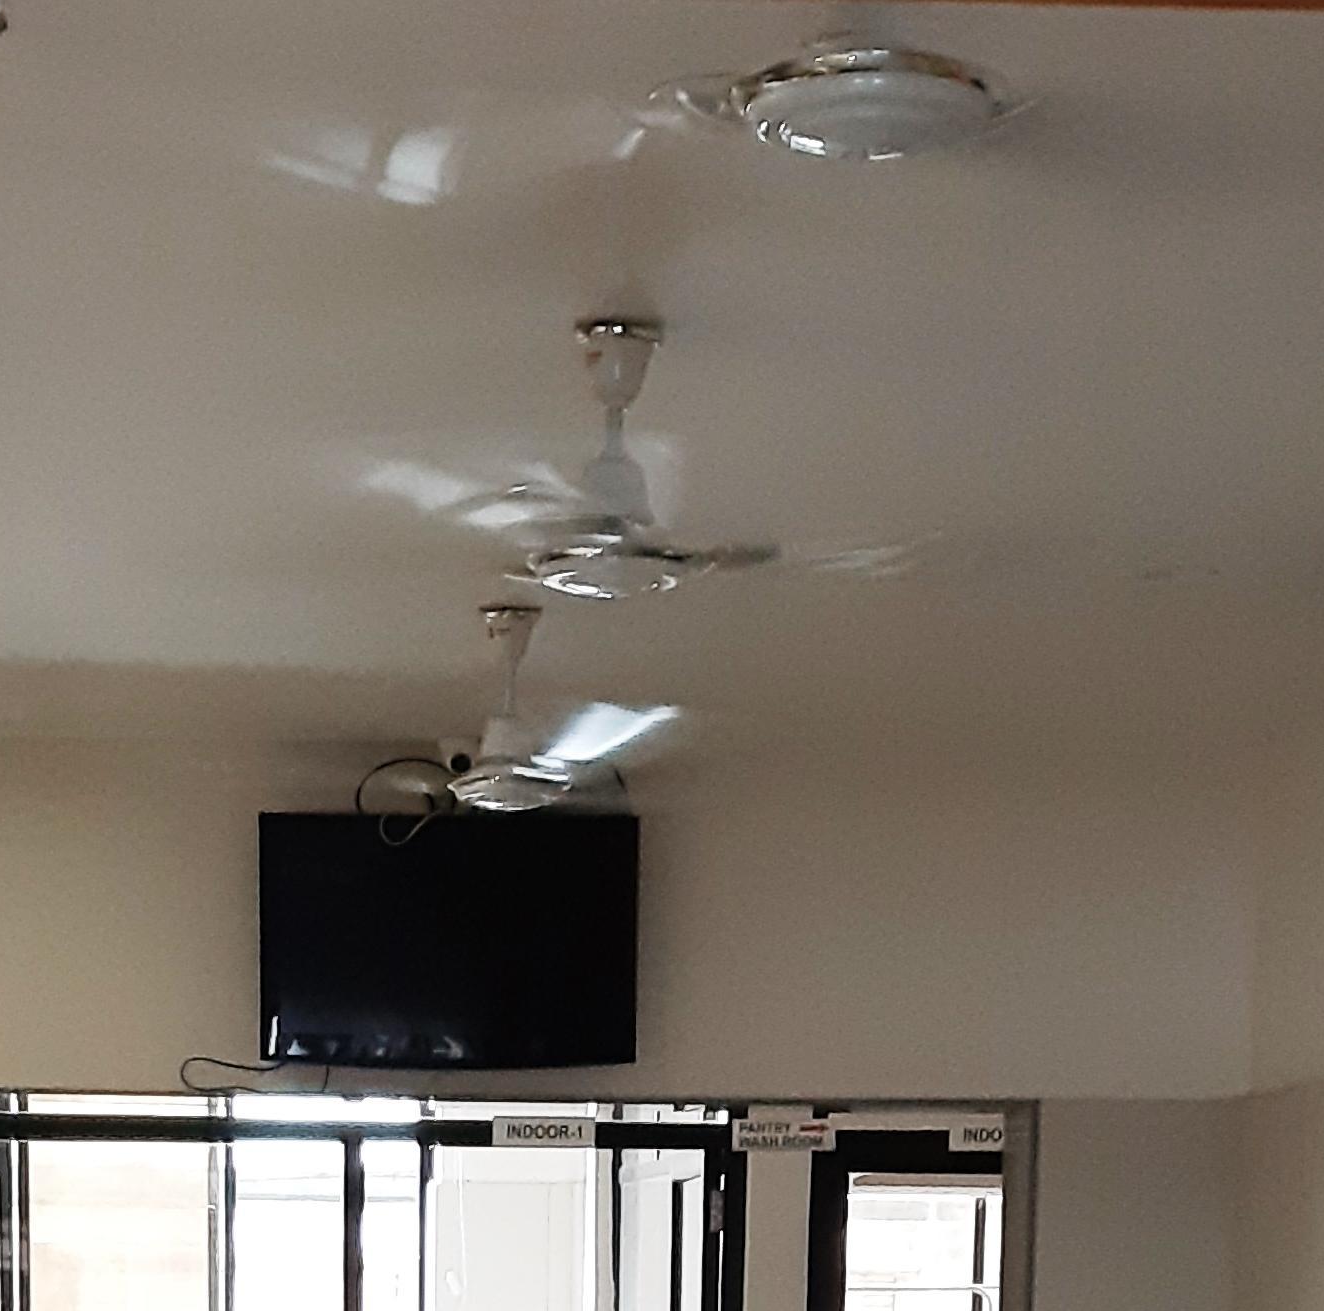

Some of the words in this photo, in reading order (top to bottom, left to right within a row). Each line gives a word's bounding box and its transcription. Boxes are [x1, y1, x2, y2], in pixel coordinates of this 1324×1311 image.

[506, 1123, 583, 1140] INDOOR-1
[739, 1121, 791, 1133] PANTRY
[962, 1127, 1003, 1142] INDO
